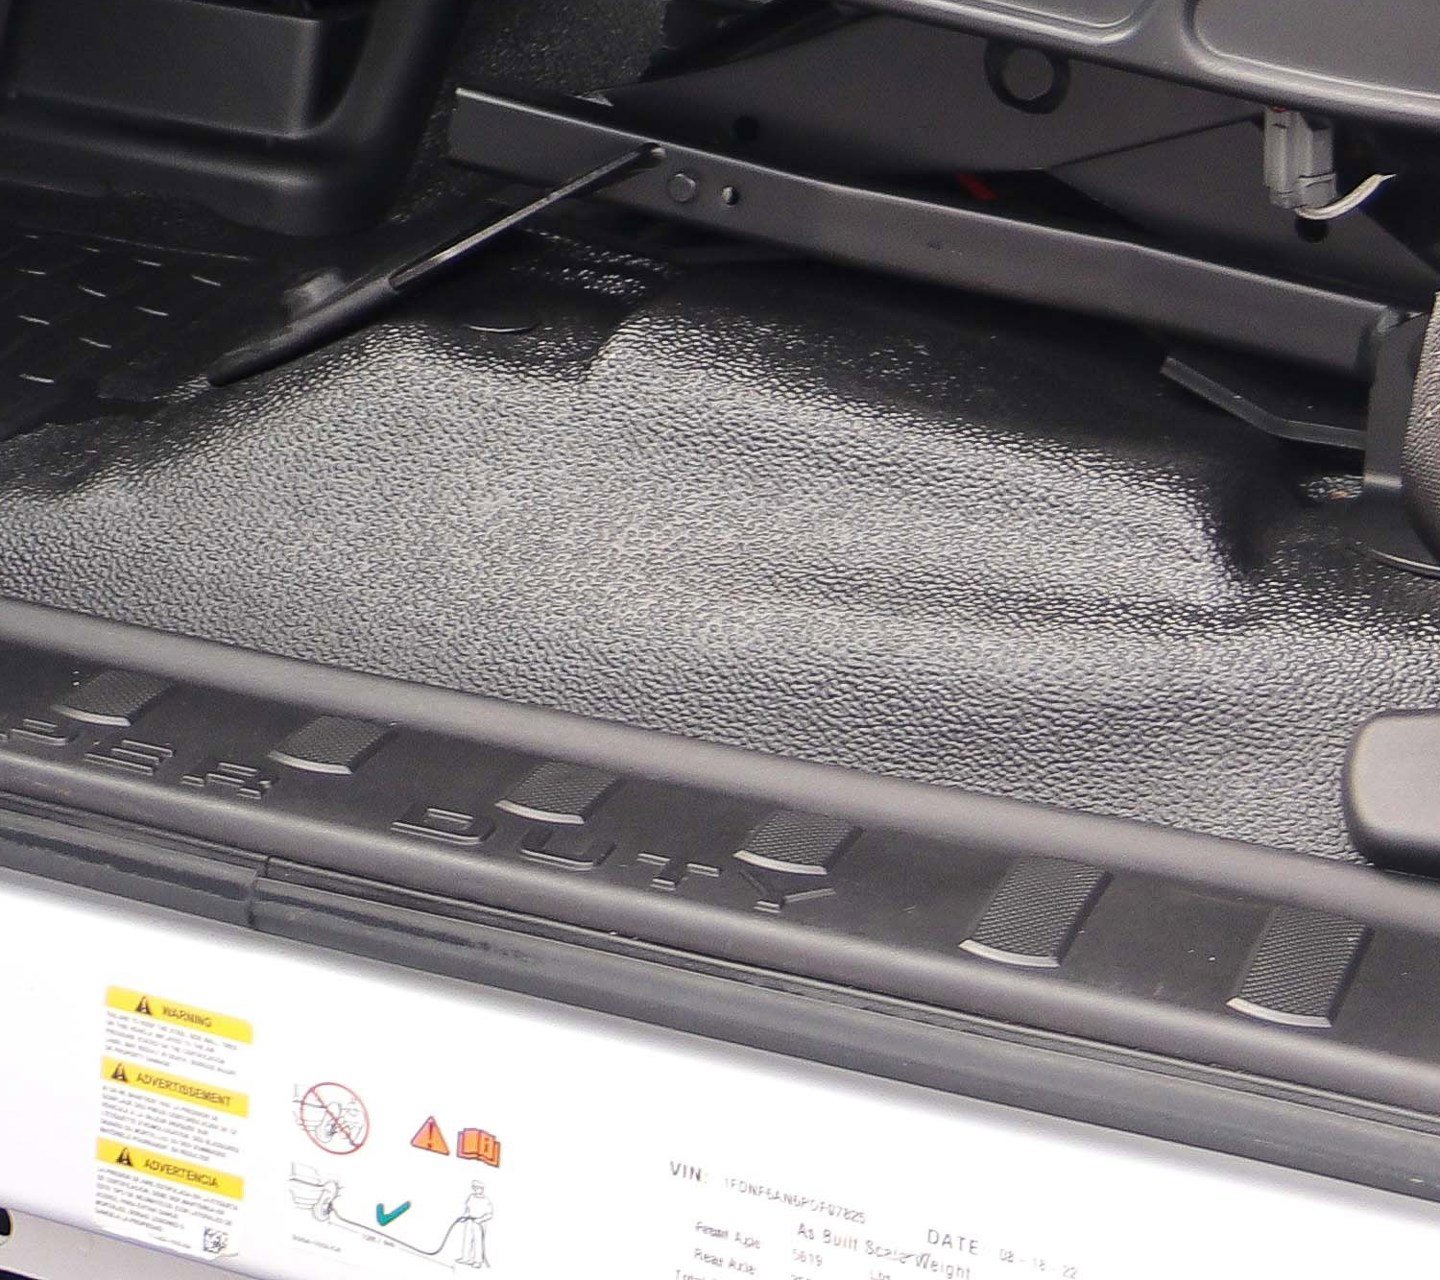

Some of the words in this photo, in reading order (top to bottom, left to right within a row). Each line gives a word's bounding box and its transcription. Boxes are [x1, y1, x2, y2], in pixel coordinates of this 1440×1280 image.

[390, 803, 838, 916] DUTY
[162, 1005, 213, 1028] WARNING
[136, 1072, 232, 1107] ADVERTISSEMENT
[143, 1157, 221, 1188] ADVERTENCIA
[798, 1222, 815, 1241] As
[914, 1251, 972, 1280] Weight
